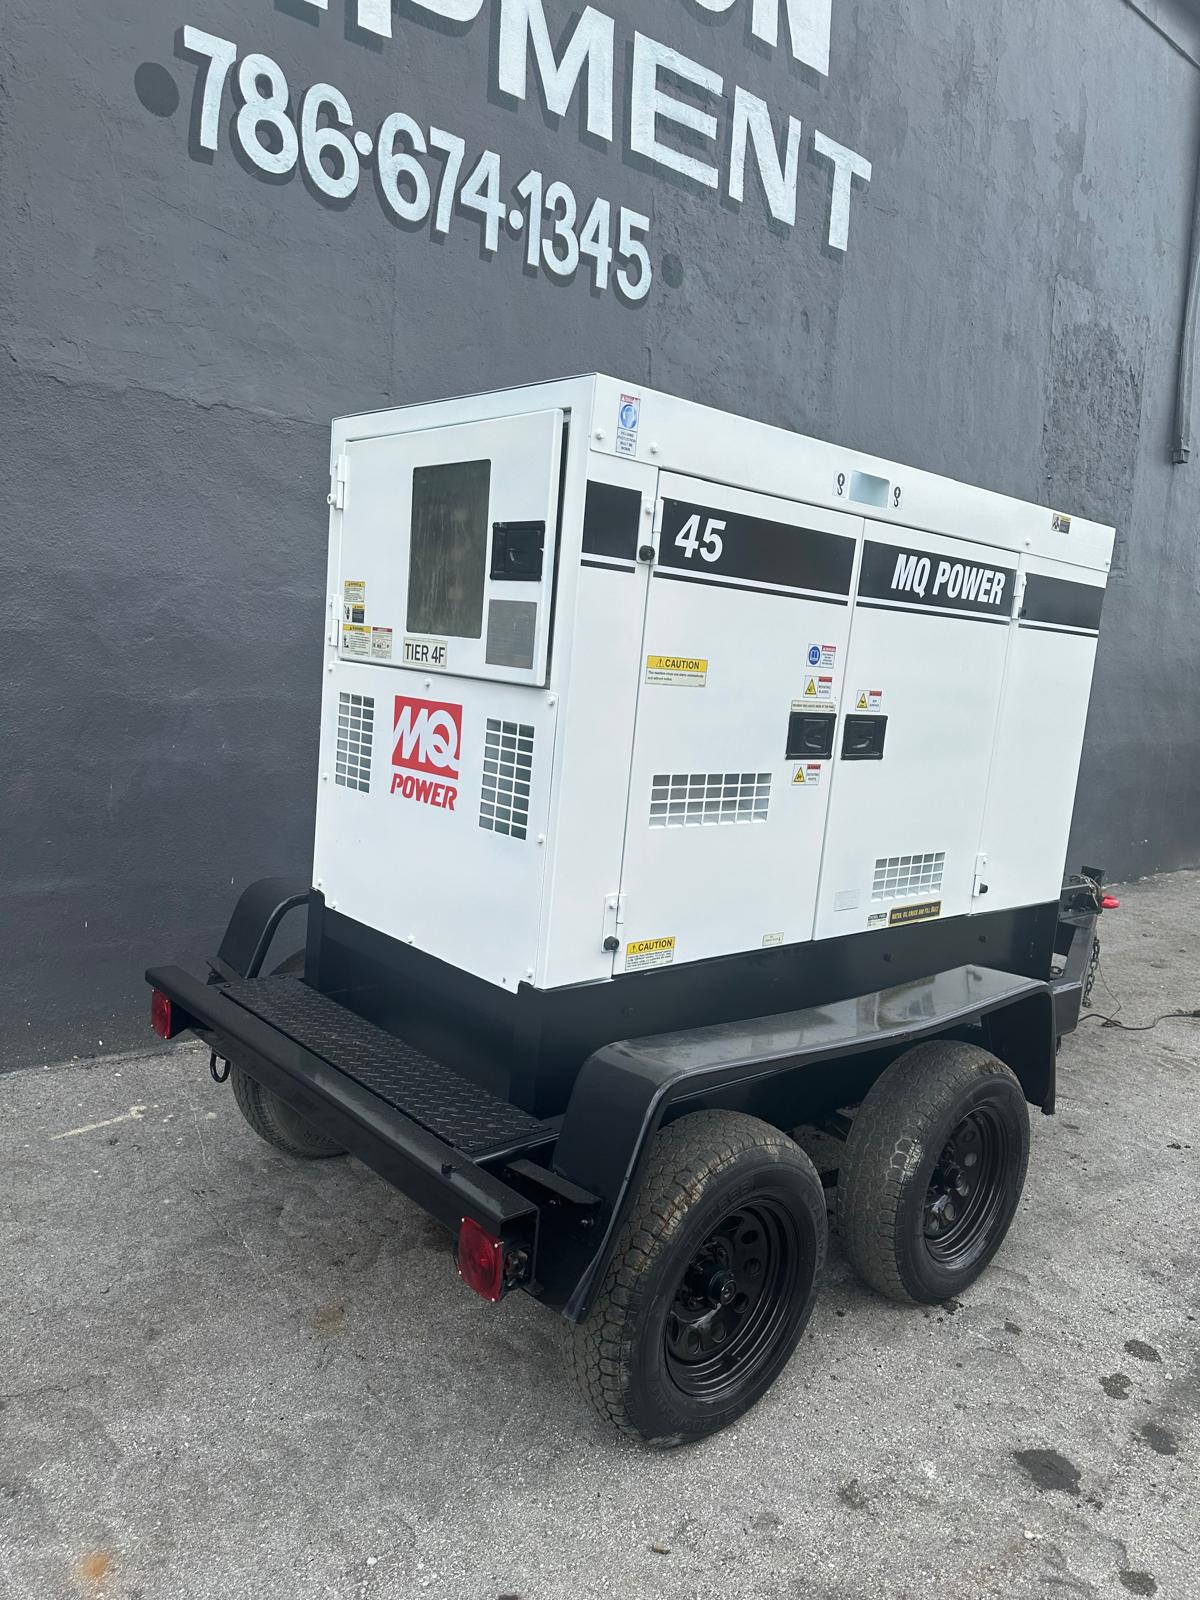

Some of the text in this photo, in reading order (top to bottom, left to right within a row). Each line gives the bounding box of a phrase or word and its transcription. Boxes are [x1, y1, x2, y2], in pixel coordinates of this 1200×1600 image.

[306, 0, 872, 253] MENT
[674, 514, 727, 563] 45
[890, 553, 1006, 605] MQ POWER
[405, 643, 429, 662] TIER
[431, 645, 446, 664] 4F
[665, 658, 700, 670] CAUTION
[391, 705, 461, 772] MQ
[390, 773, 458, 812] POWER
[638, 938, 673, 952] CAUTION
